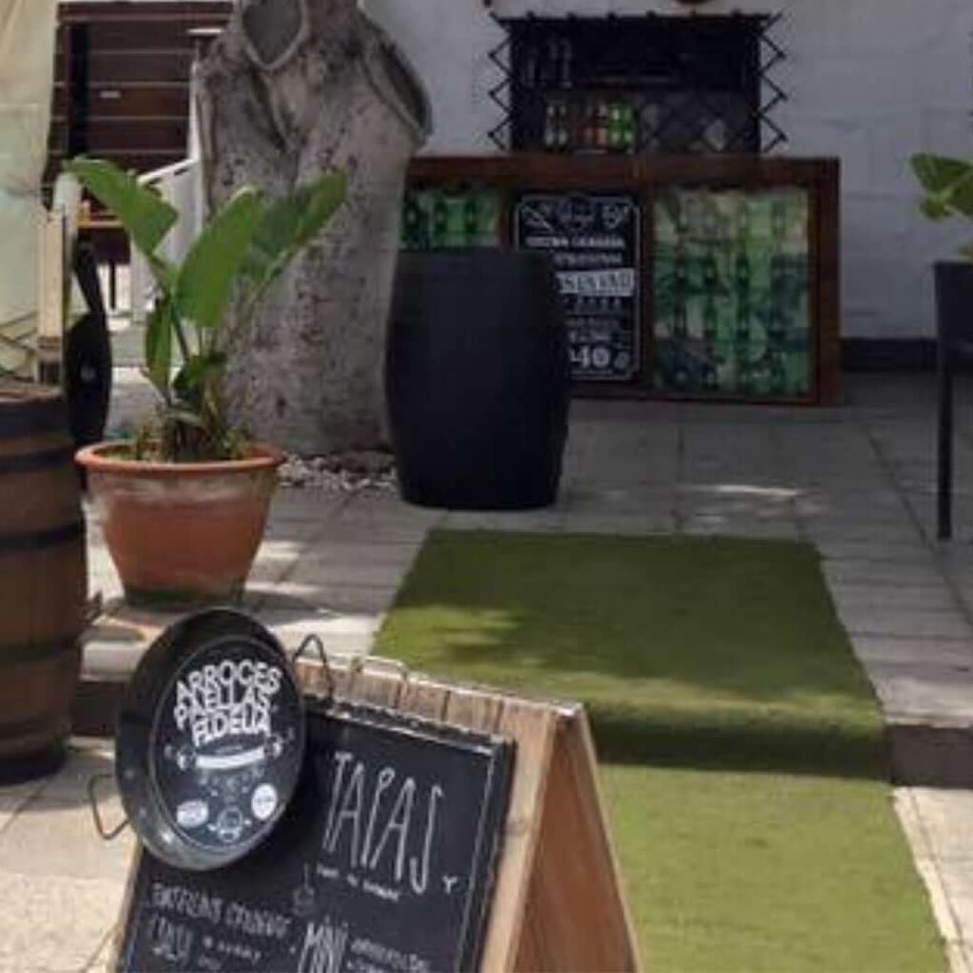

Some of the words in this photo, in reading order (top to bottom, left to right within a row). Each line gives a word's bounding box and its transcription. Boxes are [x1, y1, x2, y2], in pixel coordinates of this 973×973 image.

[173, 683, 272, 731] PAELLAS
[176, 658, 282, 708] ARROCES
[323, 751, 443, 895] TAPAS
